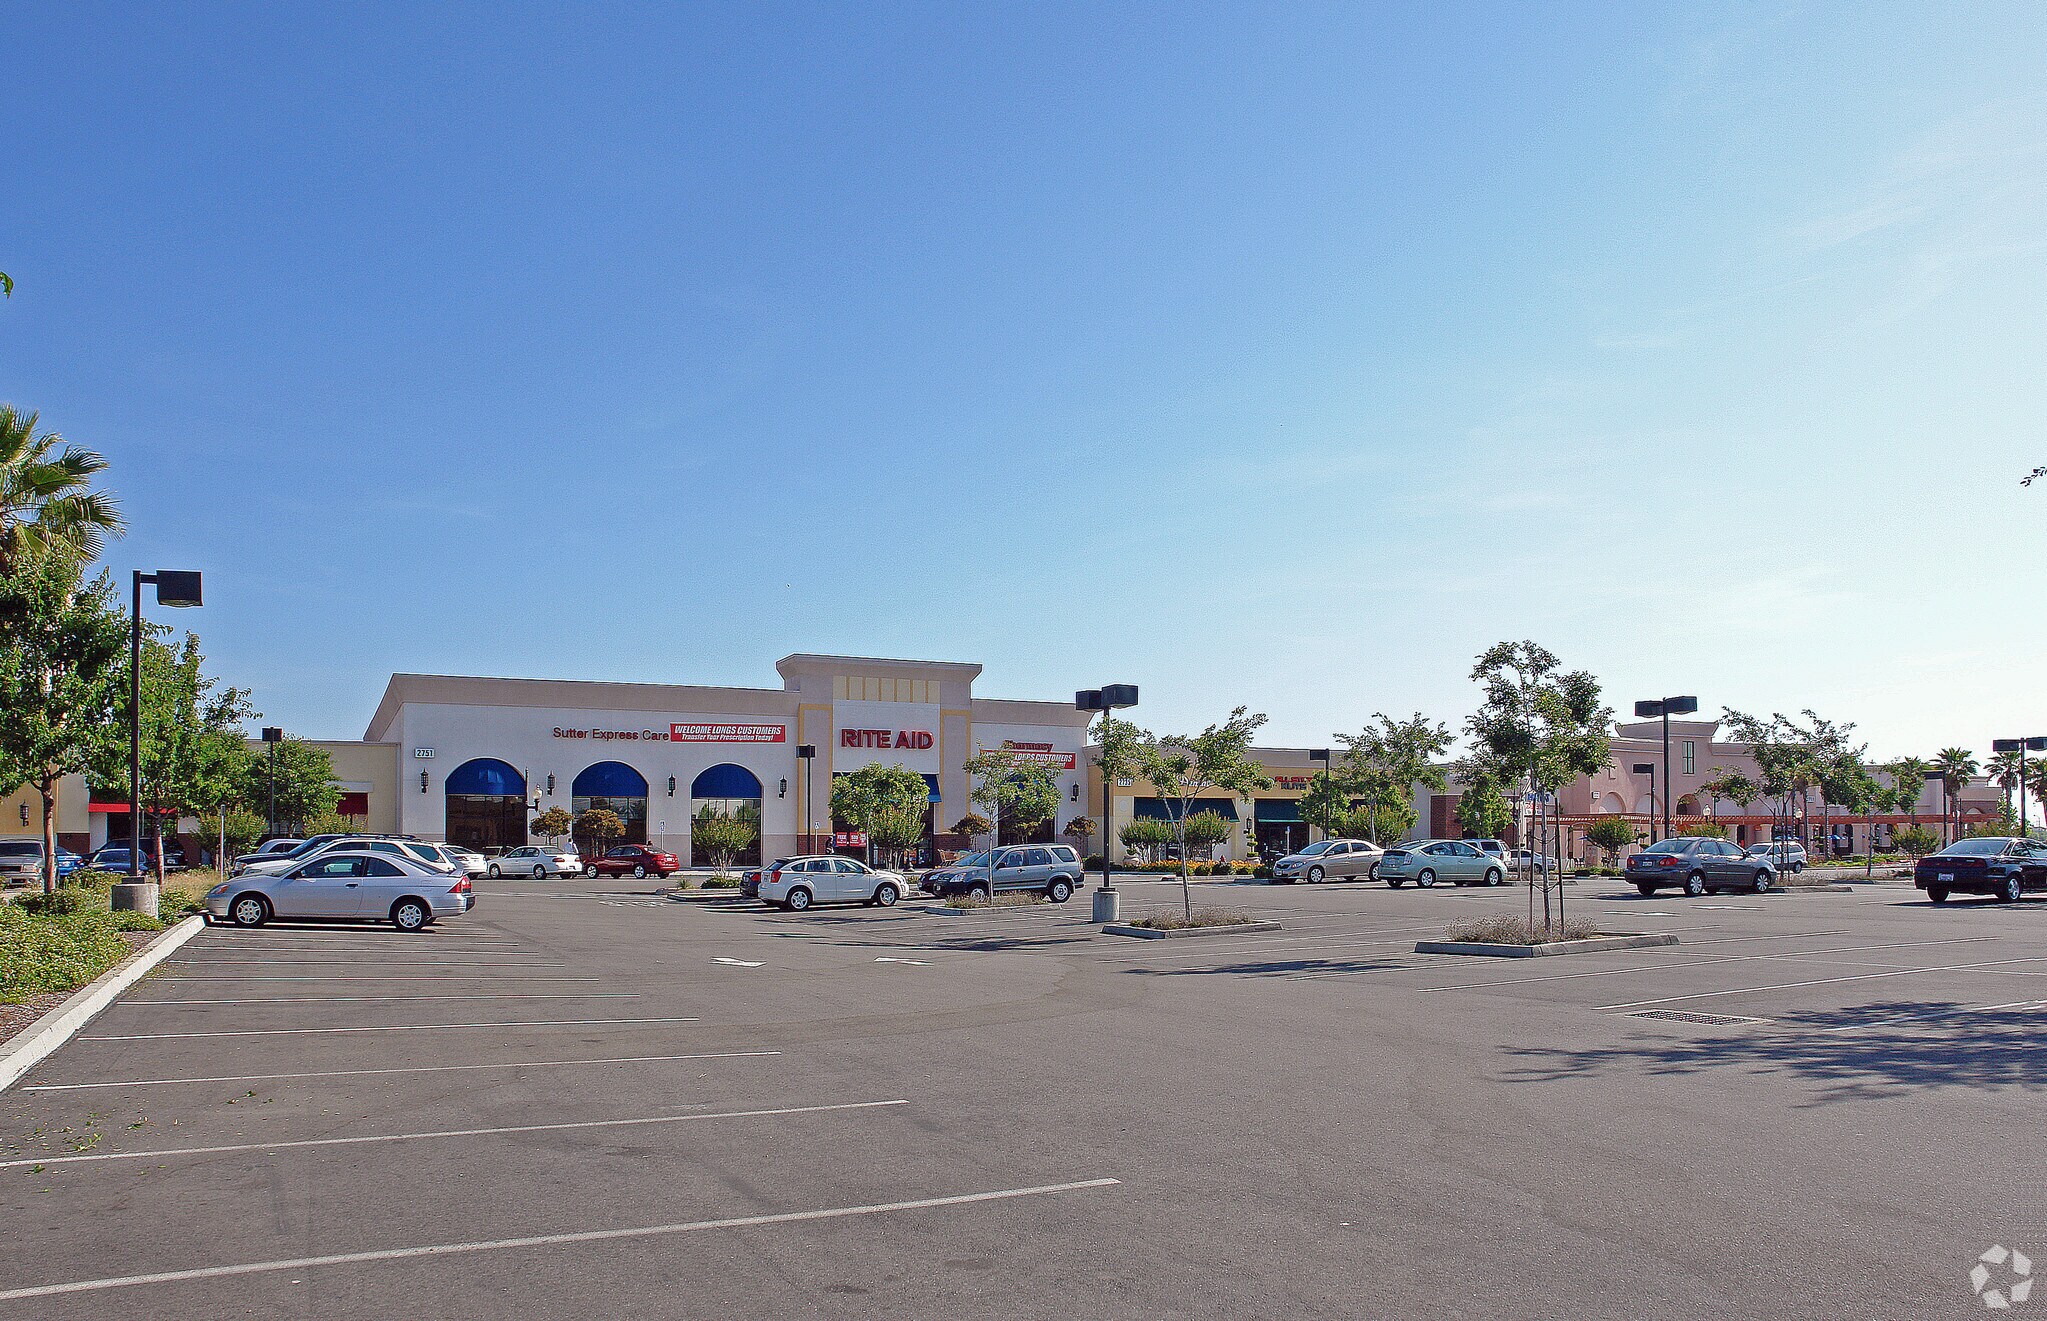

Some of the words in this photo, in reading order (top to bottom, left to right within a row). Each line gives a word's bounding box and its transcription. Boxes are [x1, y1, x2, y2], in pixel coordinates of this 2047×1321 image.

[553, 727, 588, 738] Sutter
[592, 728, 639, 742] Express
[642, 729, 669, 741] Care
[675, 725, 711, 734] WELCOME
[712, 726, 736, 734] LONGS
[737, 726, 781, 735] CUSTOMERS
[720, 733, 754, 741] Prescription
[755, 734, 774, 742] Today!
[841, 728, 892, 749] RITE
[894, 730, 935, 750] AID
[416, 749, 433, 757] 2751
[1035, 753, 1073, 762] CUSTOMERS
